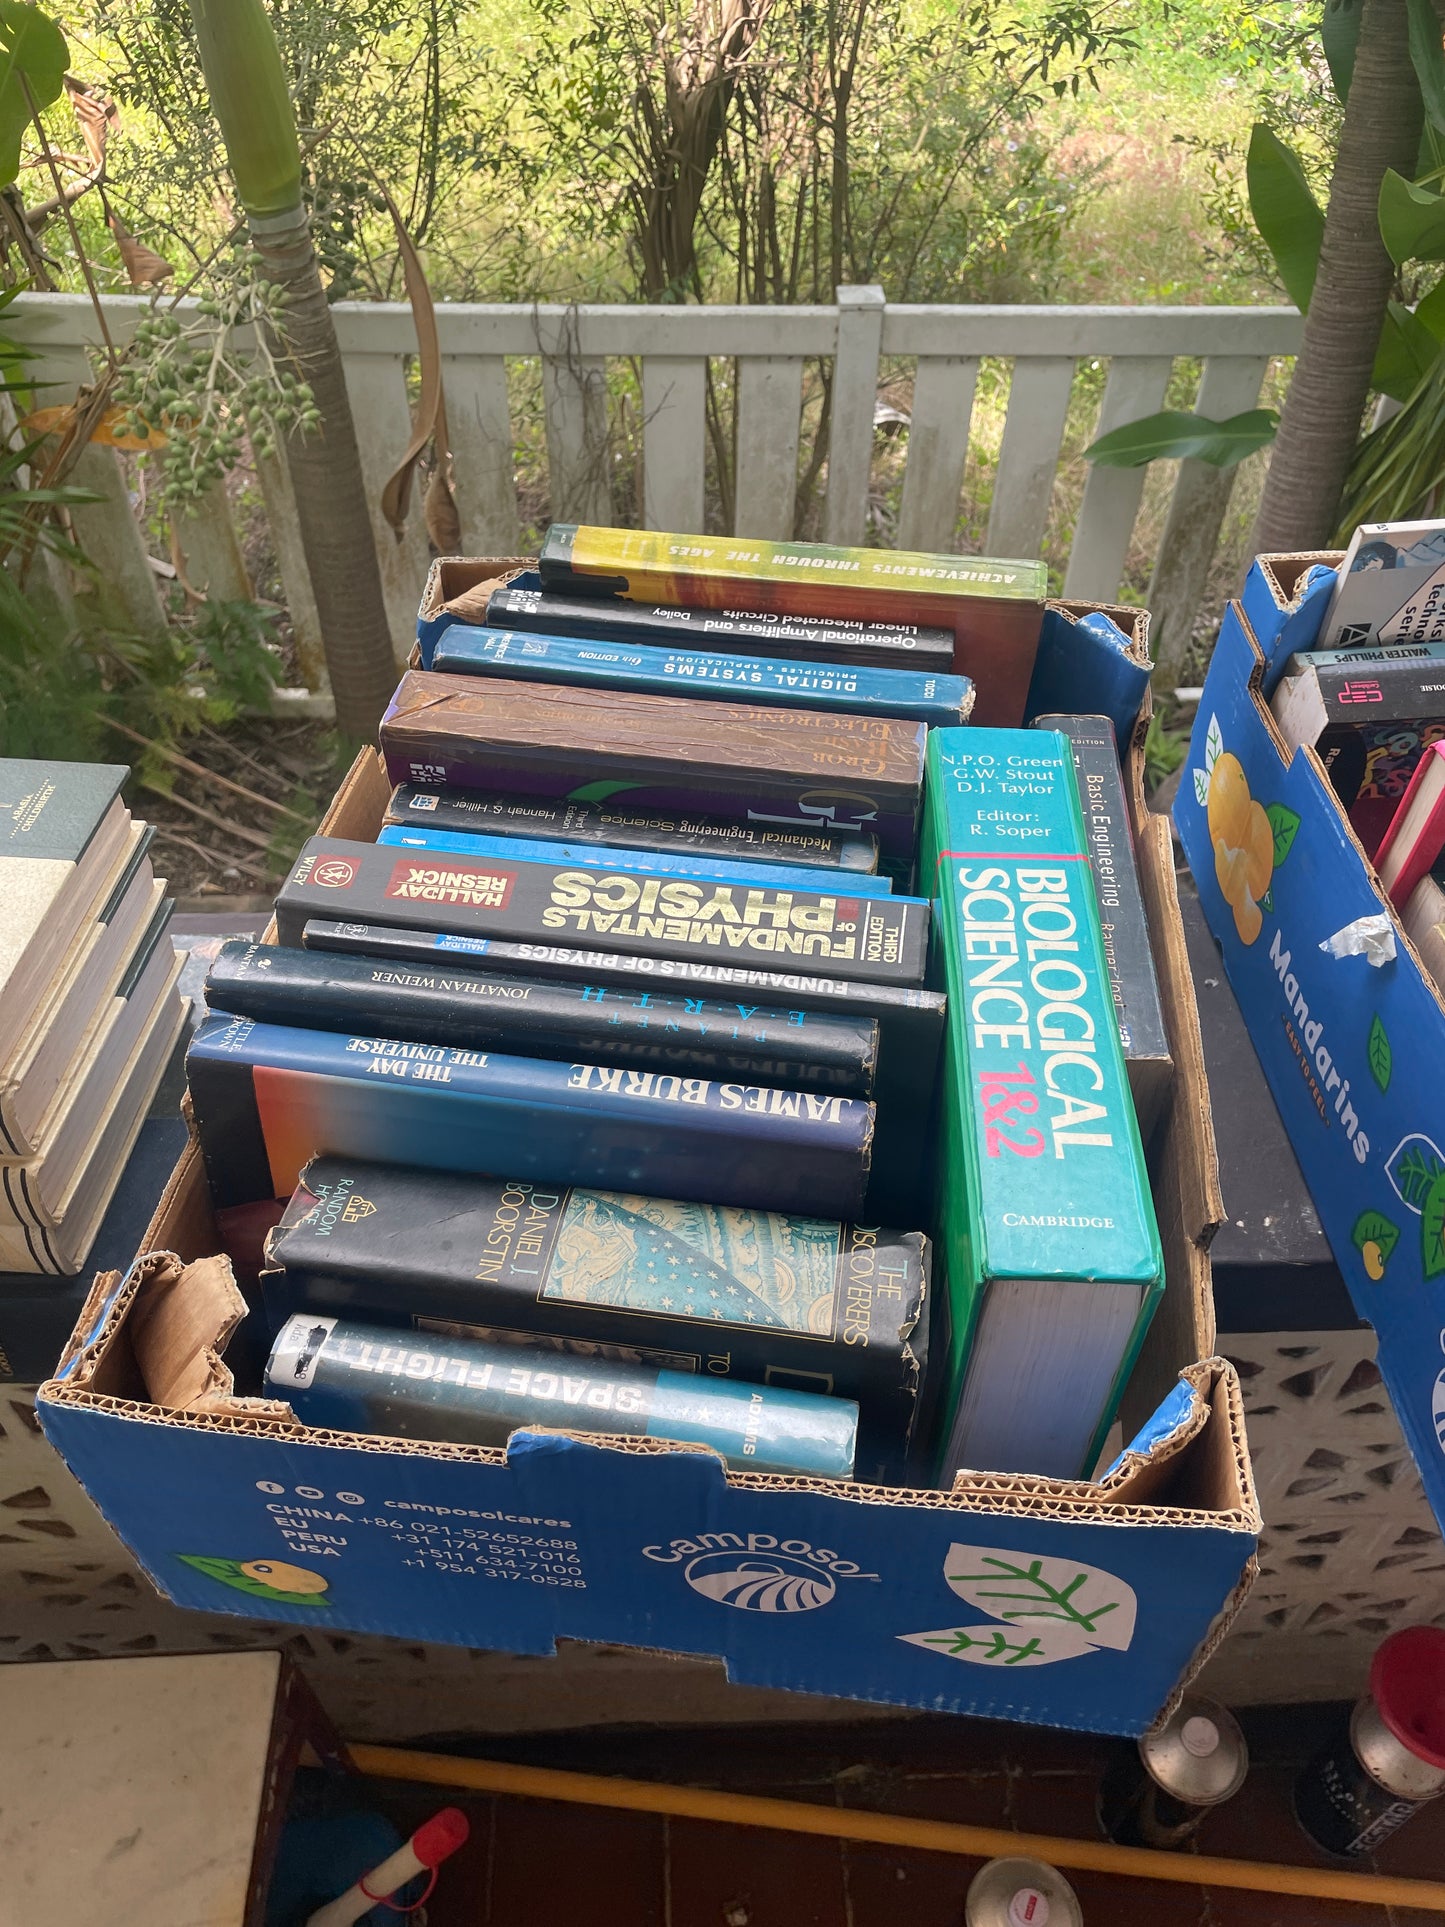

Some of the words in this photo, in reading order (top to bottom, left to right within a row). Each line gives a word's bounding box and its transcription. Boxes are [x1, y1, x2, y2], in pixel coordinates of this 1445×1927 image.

[669, 545, 716, 559] AGES
[726, 549, 760, 564] THE
[772, 553, 861, 572] THROUGH
[873, 563, 1017, 584] ACHIEVEMENTS
[652, 607, 691, 620] Dailey
[722, 609, 778, 623] Circuits
[782, 614, 863, 630] Integrated
[704, 618, 734, 633] and
[739, 621, 819, 643] Amplifiers
[868, 622, 918, 635] Linear
[827, 630, 917, 649] Operational
[577, 651, 623, 663] EDITION
[668, 655, 759, 669] APPLICATIONS
[1335, 650, 1384, 663] PHILLIPS
[1385, 647, 1431, 660] WALTER
[664, 662, 762, 683] SYSTEMS
[775, 673, 857, 692] DIGITAL
[780, 667, 857, 679] PRINCIPLES
[924, 679, 935, 699] TOCCI
[728, 709, 892, 740] ELECTRONICS
[812, 752, 888, 776] GROB
[942, 755, 1001, 766] N.P.O.
[1007, 755, 1063, 767] Green
[953, 768, 999, 779] G.W.
[1006, 769, 1055, 781] Stout
[957, 782, 992, 794] D.J.
[998, 783, 1055, 797] Taylor
[1086, 774, 1108, 811] Basic
[21, 785, 56, 832] CHILDBIRTH
[452, 800, 487, 813] Hillier
[493, 804, 503, 815] &
[507, 806, 556, 820] Hannah
[977, 809, 1040, 822] Editor:
[562, 806, 577, 830] Edition
[574, 809, 589, 829] Third
[600, 814, 675, 831] Science
[680, 820, 755, 843] Engineering
[762, 832, 832, 852] Mechanical
[970, 824, 988, 836] R.
[995, 825, 1053, 839] Soper
[293, 855, 318, 886] WILEY
[1093, 815, 1121, 908] Engineering
[408, 868, 508, 893] RESNICK
[393, 884, 503, 907] HALLIDAY
[550, 871, 837, 933] PHYSICS
[542, 906, 857, 960] FUNDAMENTALS
[835, 921, 857, 933] OF
[437, 939, 485, 952] HALLIDAY
[446, 935, 487, 944] RESNICK
[867, 916, 885, 962] EDITION
[882, 926, 900, 964] THIRD
[233, 944, 259, 981] BANTAM
[517, 944, 620, 966] PHYSICS
[624, 956, 654, 972] OF
[958, 867, 1032, 1049] SCIENCE
[372, 971, 436, 988] WEINER
[660, 961, 848, 996] FUNDAMENTALS
[438, 980, 533, 1000] JONATHAN
[1016, 868, 1113, 1160] BIOLOGICAL
[228, 1020, 256, 1053] ITTLE,
[608, 1011, 767, 1043] PLANET
[345, 1038, 444, 1063] UNIVERSE
[1269, 929, 1370, 1164] Mandarins
[366, 1057, 407, 1078] DAY
[449, 1050, 489, 1068] THE
[1284, 1020, 1301, 1055] EASY
[1301, 1057, 1311, 1077] TO
[1308, 1078, 1327, 1118] PEEL
[411, 1065, 452, 1083] THE
[567, 1063, 712, 1105] BURKE
[720, 1083, 853, 1124] JAMES
[978, 1061, 1045, 1159] 1&2
[315, 1178, 354, 1237] RANDOM
[515, 1192, 560, 1259] DANIEL
[1002, 1212, 1116, 1229] CAMBRIDGE
[475, 1182, 534, 1283] BOORSTIN
[510, 1263, 538, 1277] J.
[877, 1260, 909, 1301] THE
[350, 1343, 492, 1391] FLIGHT
[707, 1352, 731, 1374] TO
[504, 1367, 643, 1414] SPACE
[742, 1393, 765, 1457] ADAMS
[384, 1500, 572, 1528] camposolcares
[266, 1503, 354, 1523] CHINA
[358, 1517, 405, 1529] +86
[410, 1521, 578, 1550] 021-52652688
[274, 1517, 309, 1529] EU
[391, 1533, 430, 1545] +31
[443, 1538, 480, 1551] 174
[488, 1544, 581, 1564] 521-016
[281, 1529, 348, 1546] PERU
[414, 1548, 464, 1561] +511
[475, 1555, 582, 1577] 634-7100
[288, 1542, 342, 1557] USA
[402, 1558, 425, 1568] +1
[435, 1561, 477, 1575] 954
[485, 1567, 588, 1589] 317-0528
